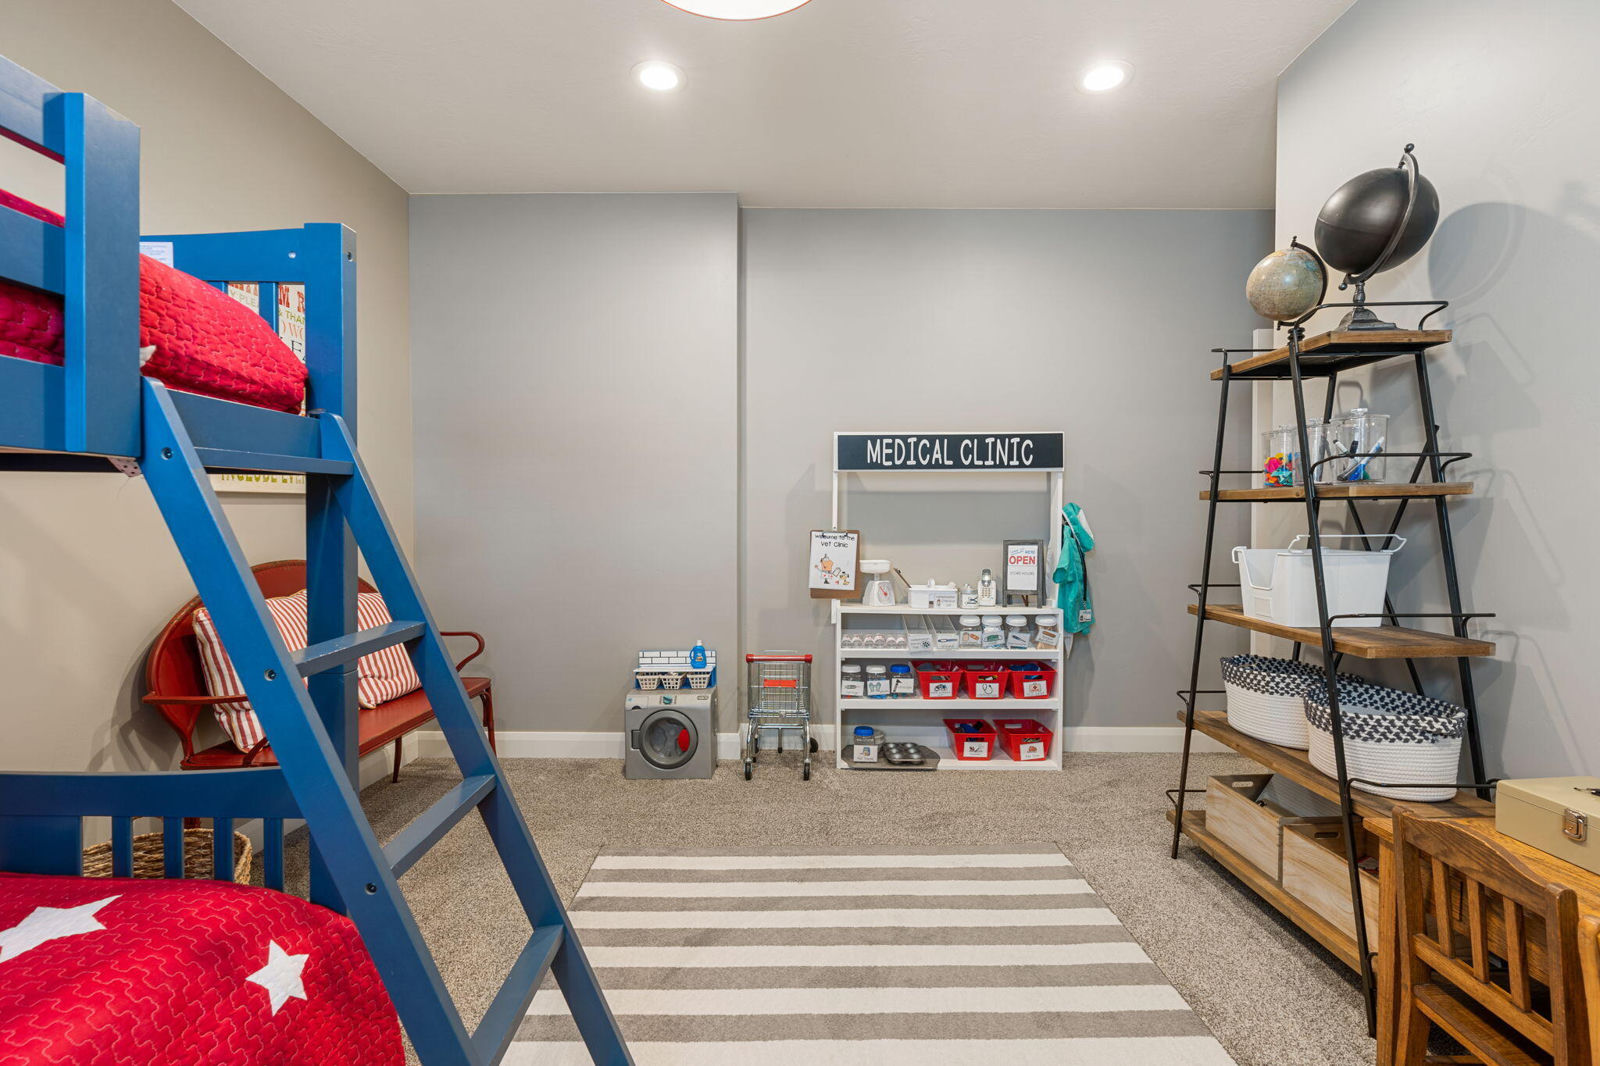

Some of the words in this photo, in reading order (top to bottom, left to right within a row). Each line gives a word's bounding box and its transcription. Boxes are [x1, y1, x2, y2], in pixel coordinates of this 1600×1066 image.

[866, 437, 954, 466] MEDICAL
[960, 437, 1034, 466] CLINIC
[1009, 555, 1036, 565] OPEN
